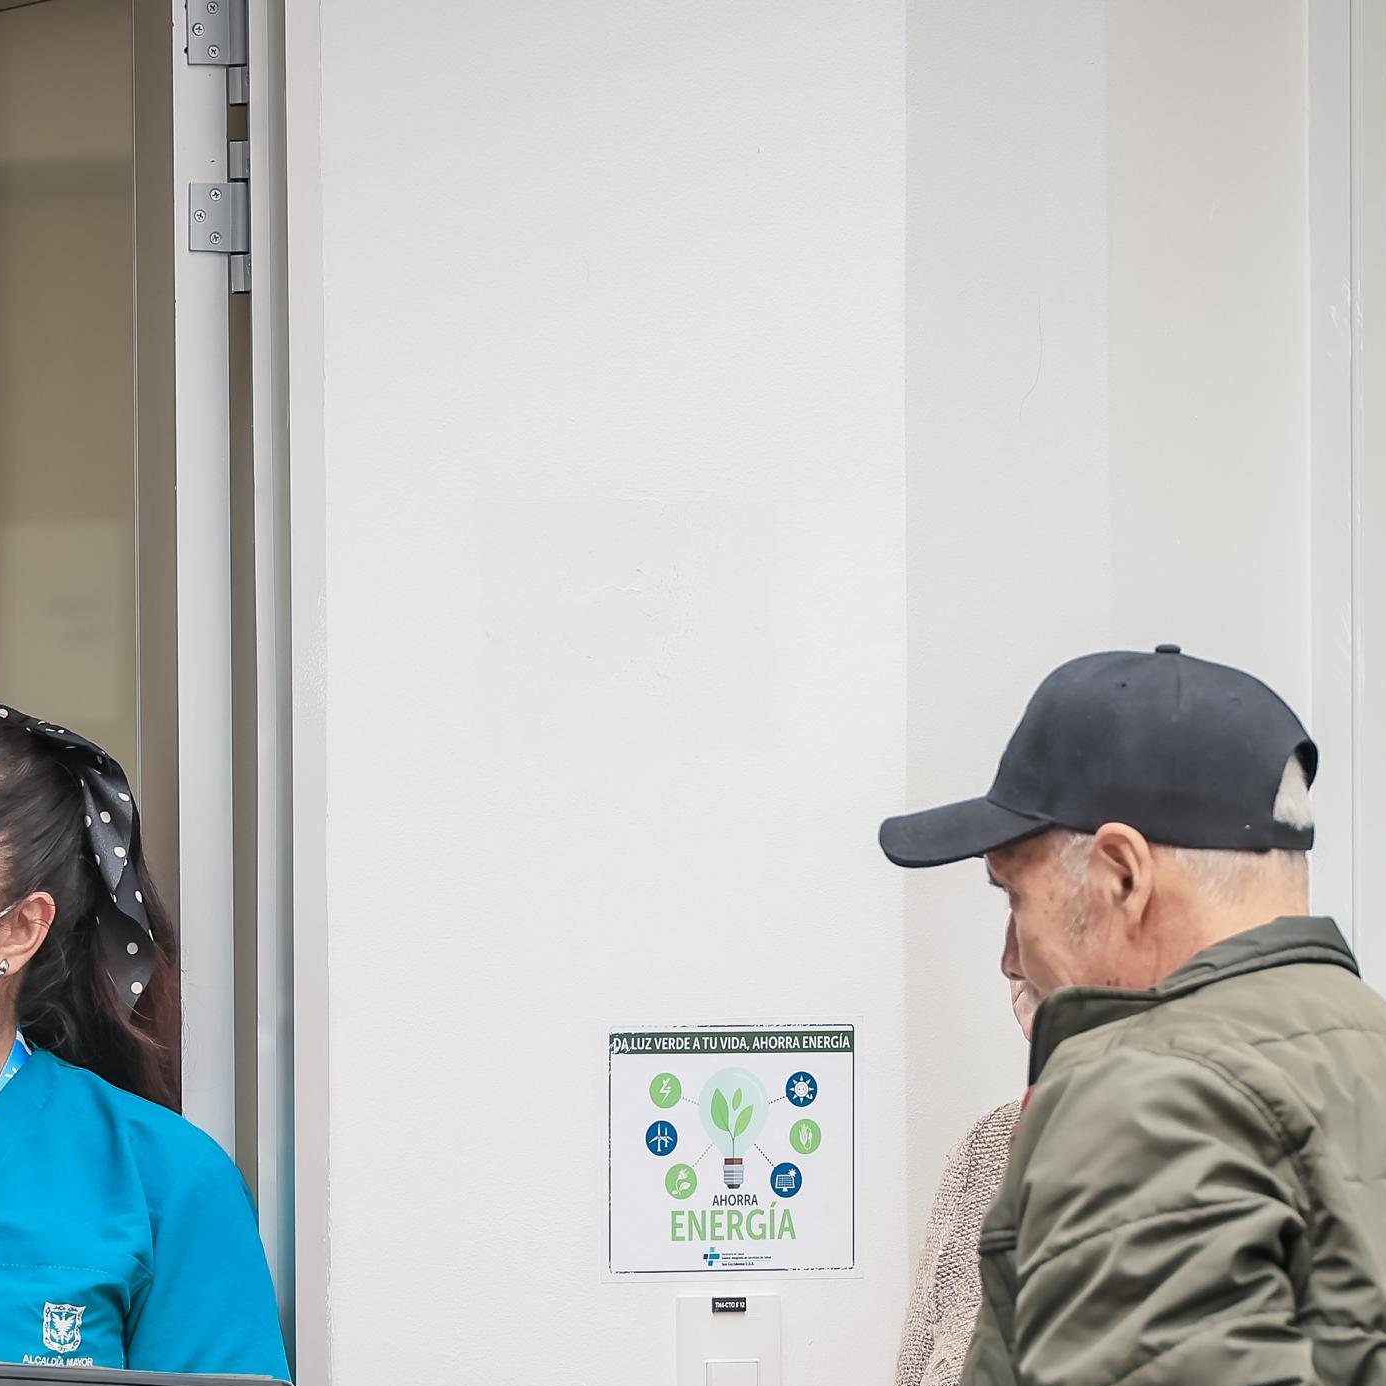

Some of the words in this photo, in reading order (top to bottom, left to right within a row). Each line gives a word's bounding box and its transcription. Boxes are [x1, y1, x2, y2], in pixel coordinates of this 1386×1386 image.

[631, 1036, 652, 1050] LUZ
[654, 1036, 691, 1050] VERDE
[693, 1036, 701, 1050] A
[702, 1036, 718, 1049] TU
[720, 1036, 749, 1051] VIDA,
[752, 1035, 800, 1049] AHORRA
[802, 1033, 850, 1049] ENERGÍA
[712, 1193, 758, 1207] AHORRA
[670, 1201, 796, 1241] ENERGÍA
[67, 1357, 94, 1368] MAYOR
